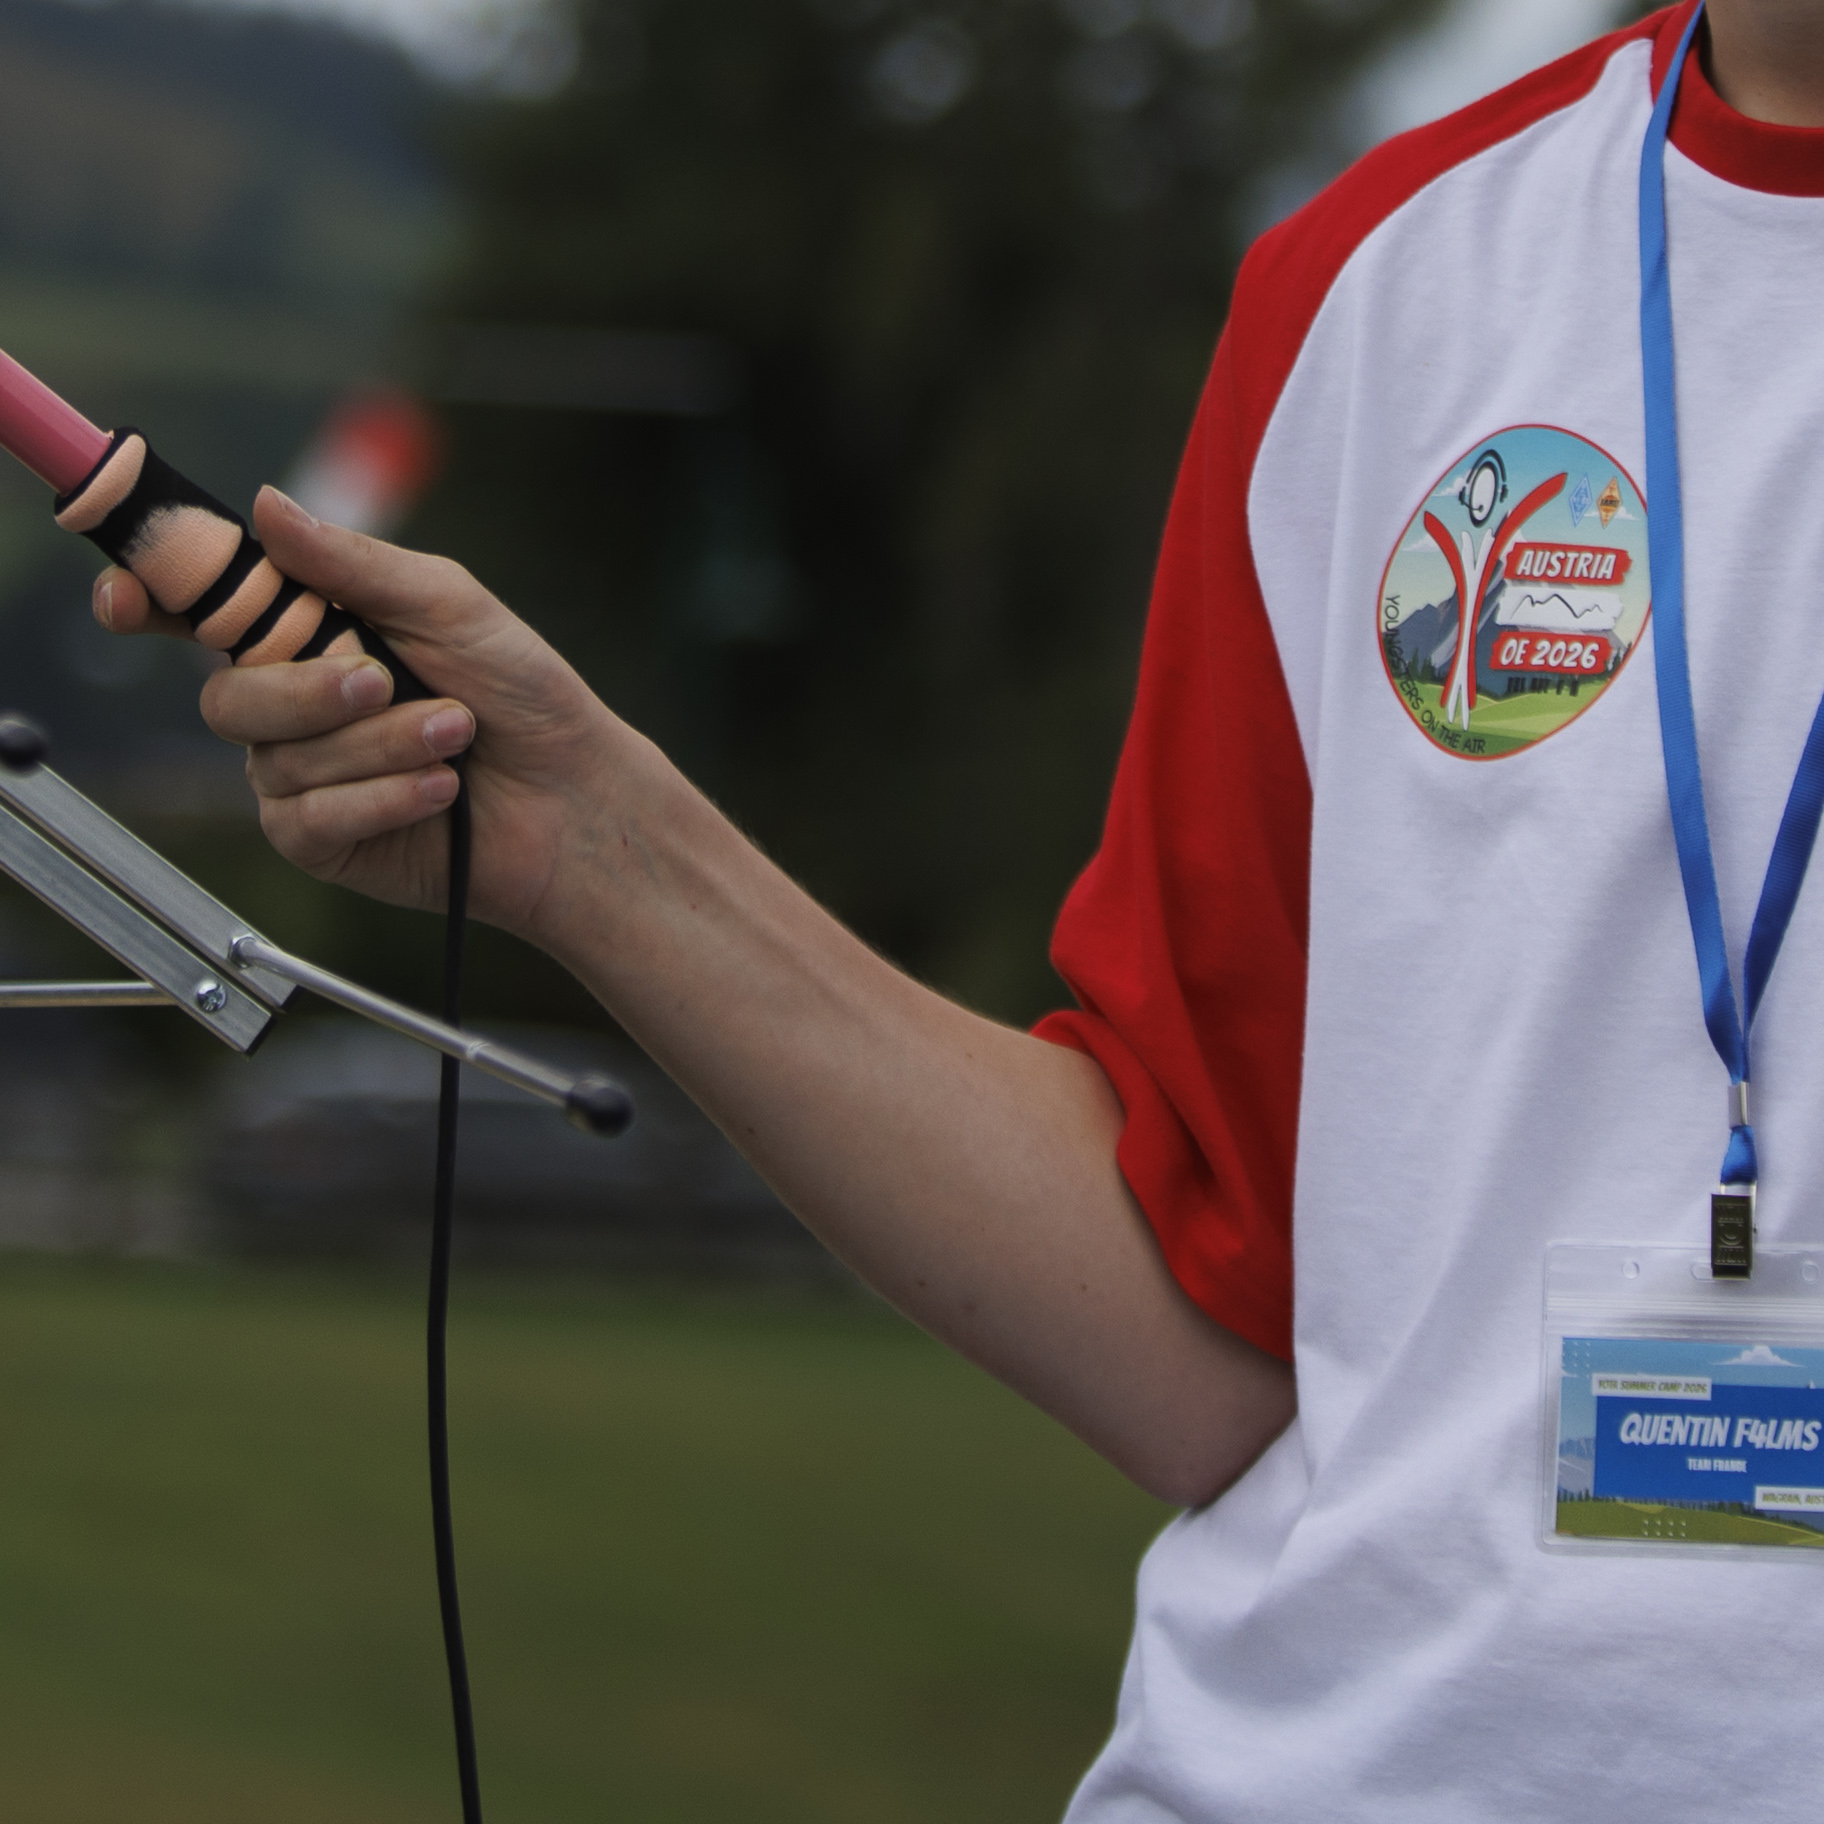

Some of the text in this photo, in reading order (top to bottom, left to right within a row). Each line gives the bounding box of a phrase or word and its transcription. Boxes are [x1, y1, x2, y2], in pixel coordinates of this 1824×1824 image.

[1517, 549, 1618, 580] AUSTRIA
[1501, 640, 1599, 668] OE 2026
[1384, 595, 1487, 755] YOUNGSTERS ON THE AIR
[1620, 1413, 1822, 1451] QUENTIN F4LMS
[1687, 1458, 1747, 1473] TEAM FRANCE
